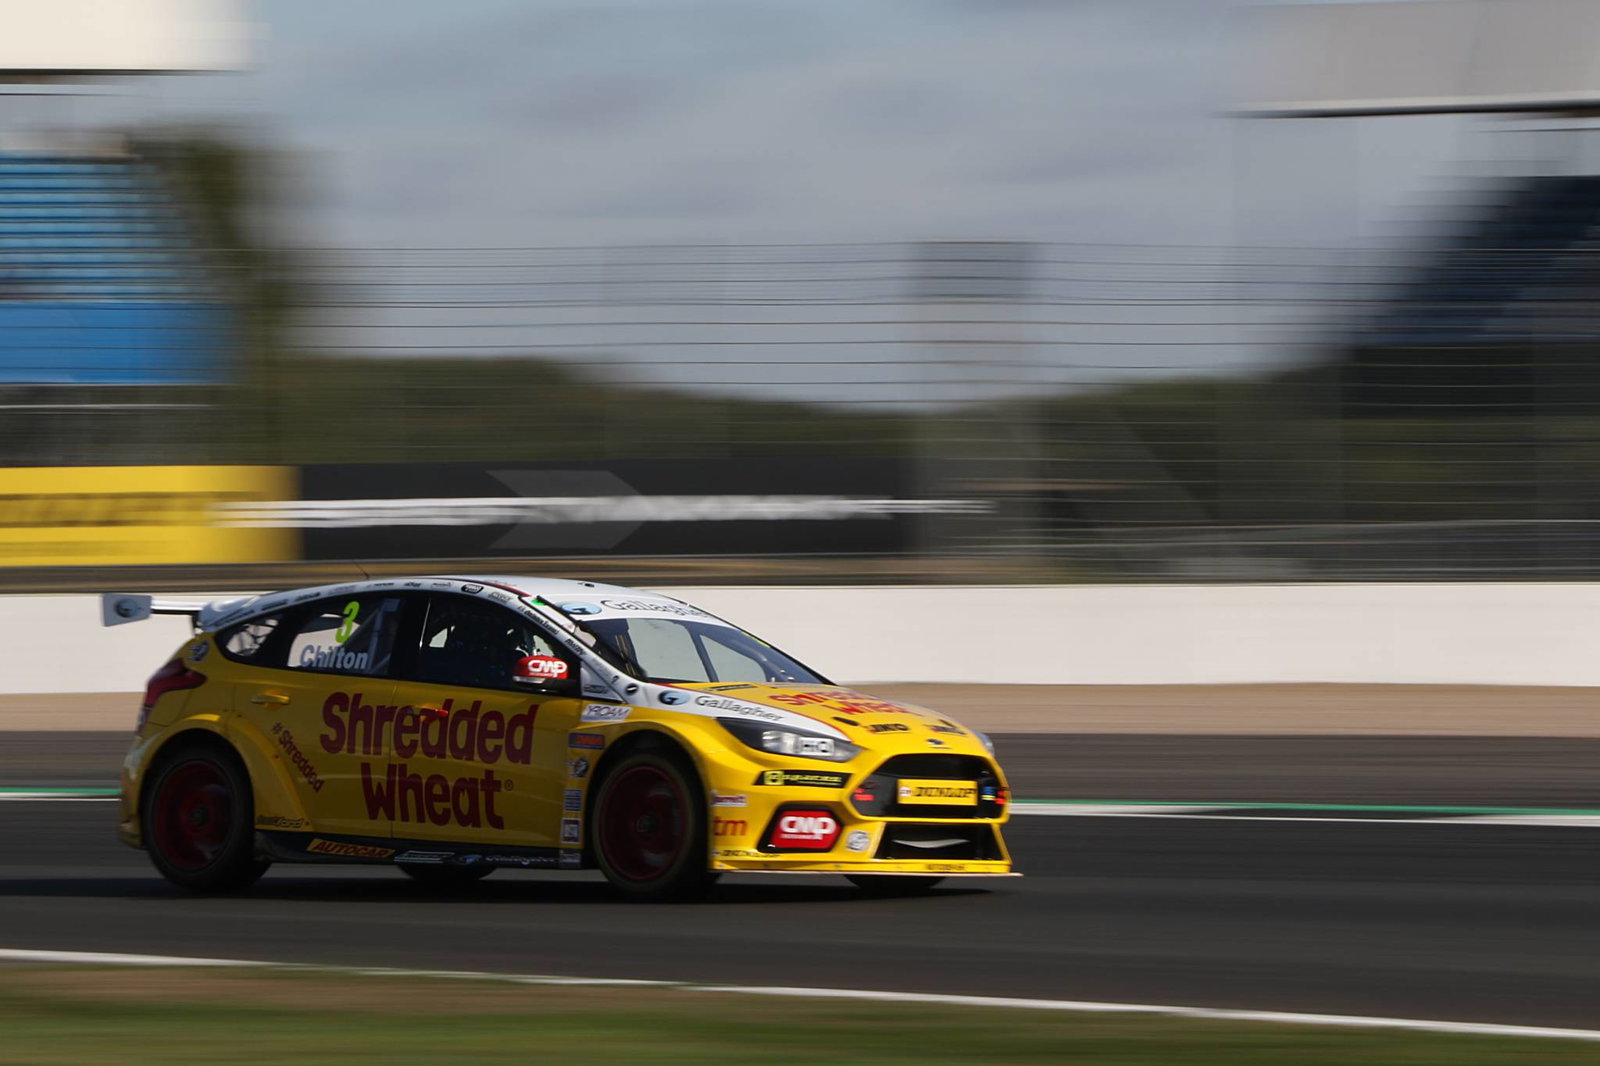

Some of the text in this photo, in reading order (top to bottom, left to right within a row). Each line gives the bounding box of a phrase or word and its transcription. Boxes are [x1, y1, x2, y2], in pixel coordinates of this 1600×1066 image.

[335, 602, 360, 643] 3
[300, 645, 369, 670] Chilton
[694, 695, 786, 722] Gallagher
[320, 691, 540, 765] Shredded
[314, 841, 389, 857] AUTOCAR
